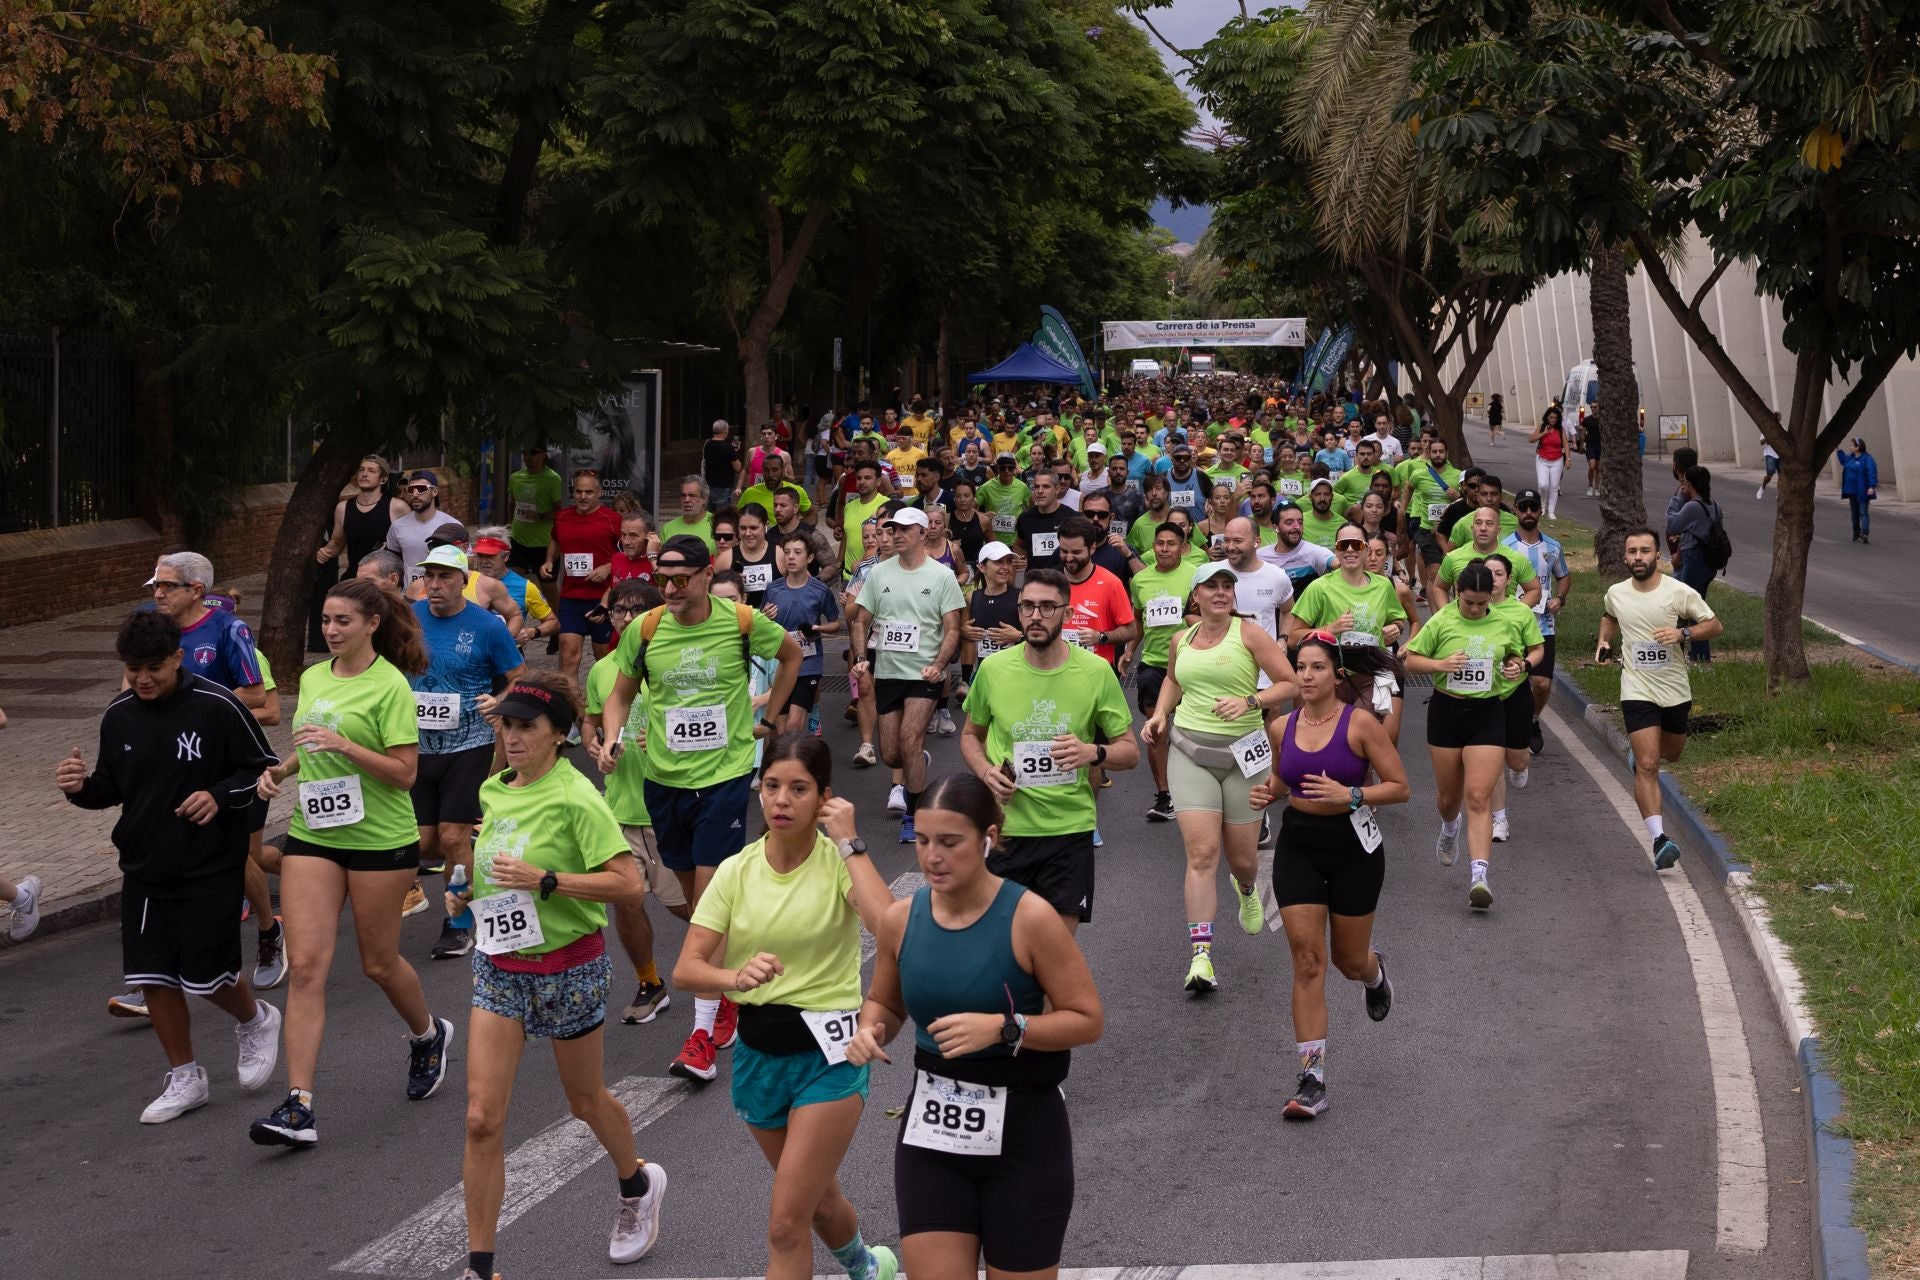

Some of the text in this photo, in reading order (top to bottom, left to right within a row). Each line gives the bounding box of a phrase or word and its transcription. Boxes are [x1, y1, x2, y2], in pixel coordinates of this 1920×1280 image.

[1156, 321, 1256, 330] Carrera de la Prensa
[1324, 341, 1348, 374] Unicaja
[601, 479, 630, 488] OSSY
[1174, 495, 1191, 504] 719
[995, 520, 1012, 532] 766
[1041, 540, 1055, 549] 18
[567, 561, 588, 570] 315
[1150, 606, 1178, 617] 1170
[887, 631, 912, 643] 887
[1637, 649, 1667, 661] 396
[1452, 669, 1486, 682] 950
[416, 704, 451, 719] 842
[673, 721, 717, 738] 482
[1244, 739, 1271, 763] 485
[1022, 757, 1059, 774] 39
[307, 793, 351, 815] 803
[483, 909, 527, 938] 758
[824, 1012, 860, 1042] 97
[922, 1099, 986, 1133] 889
